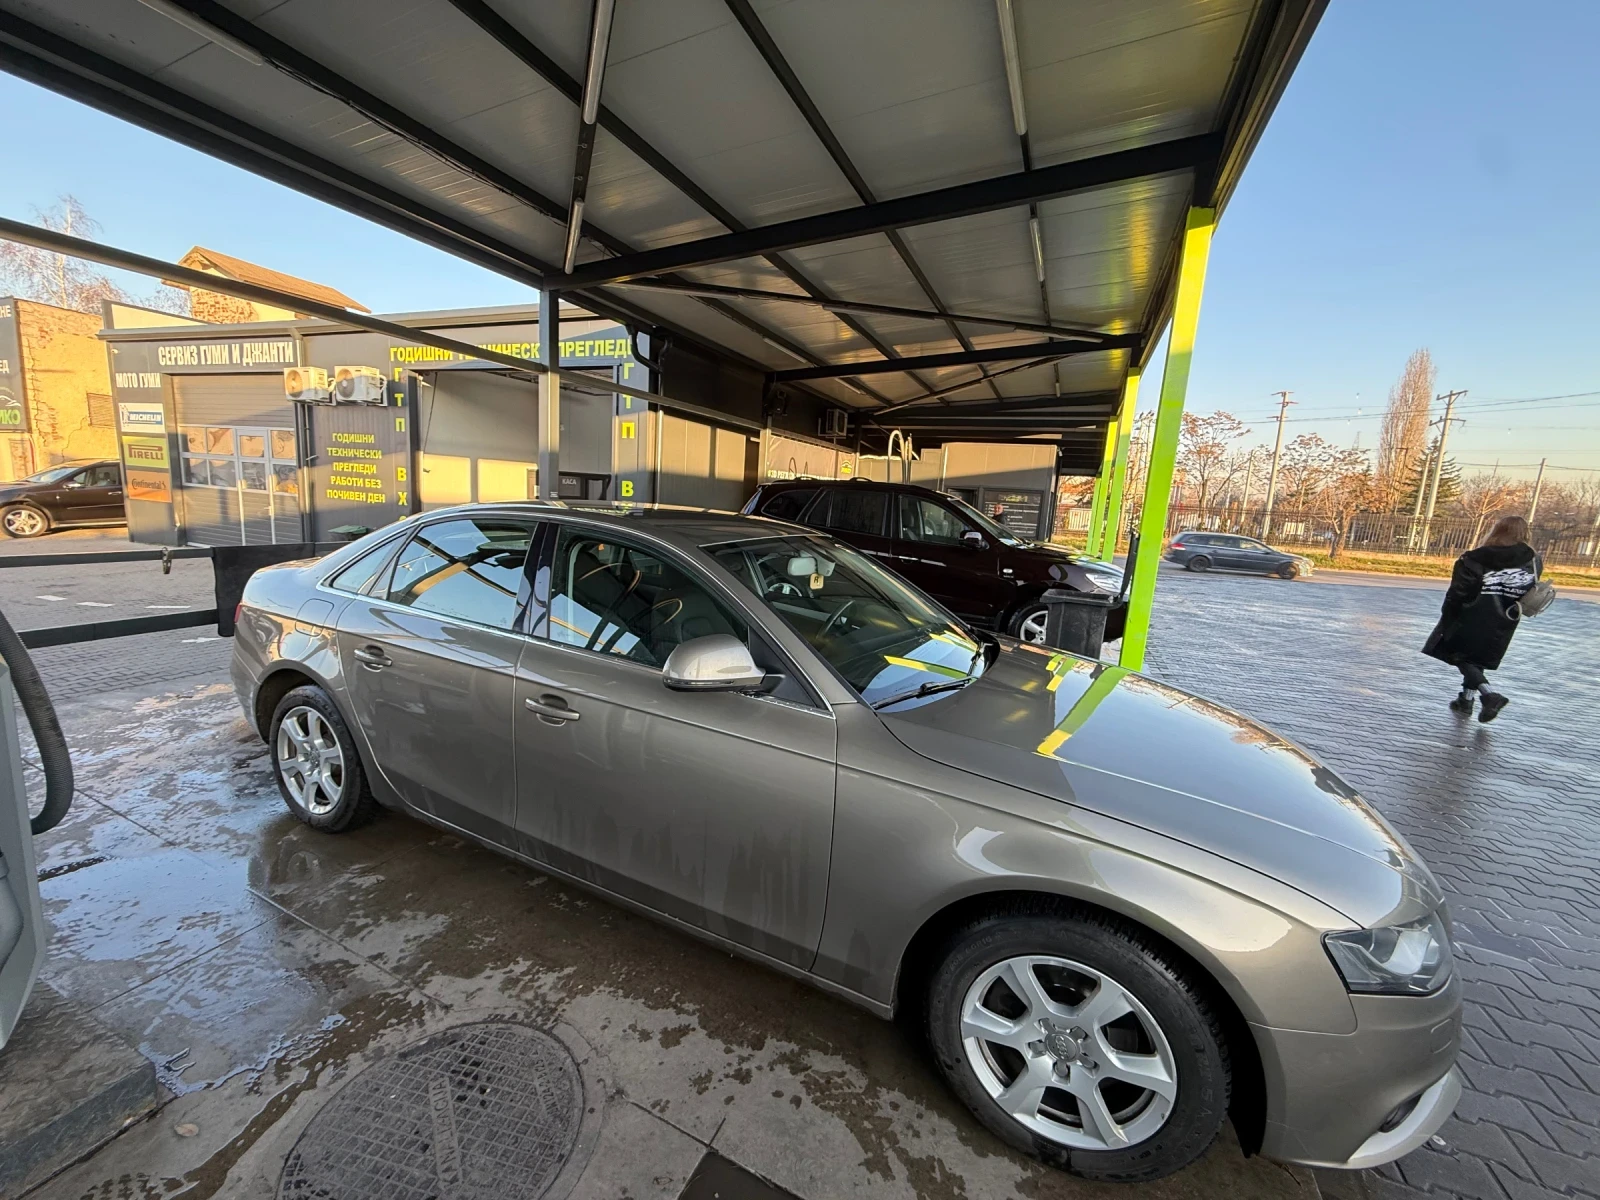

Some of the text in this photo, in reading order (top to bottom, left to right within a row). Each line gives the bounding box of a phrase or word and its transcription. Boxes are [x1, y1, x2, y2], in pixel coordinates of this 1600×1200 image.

[158, 341, 294, 366] СЕРВИЗ ГУМИ И ДЖАНТИ
[390, 346, 453, 364] ГОДИШНИ
[115, 372, 161, 388] МОТО ГУМИ
[129, 413, 162, 421] MICHELIN
[332, 433, 375, 444] ГОДИШНИ
[128, 444, 164, 460] PIRELLI
[327, 447, 382, 459] ТЕХНИЧЕСКИ
[333, 462, 377, 475] ПРЕГЛЕДИ
[330, 476, 382, 489] РАБОТИ БЕЗ
[327, 490, 386, 504] ПОЧИВЕН ДЕН
